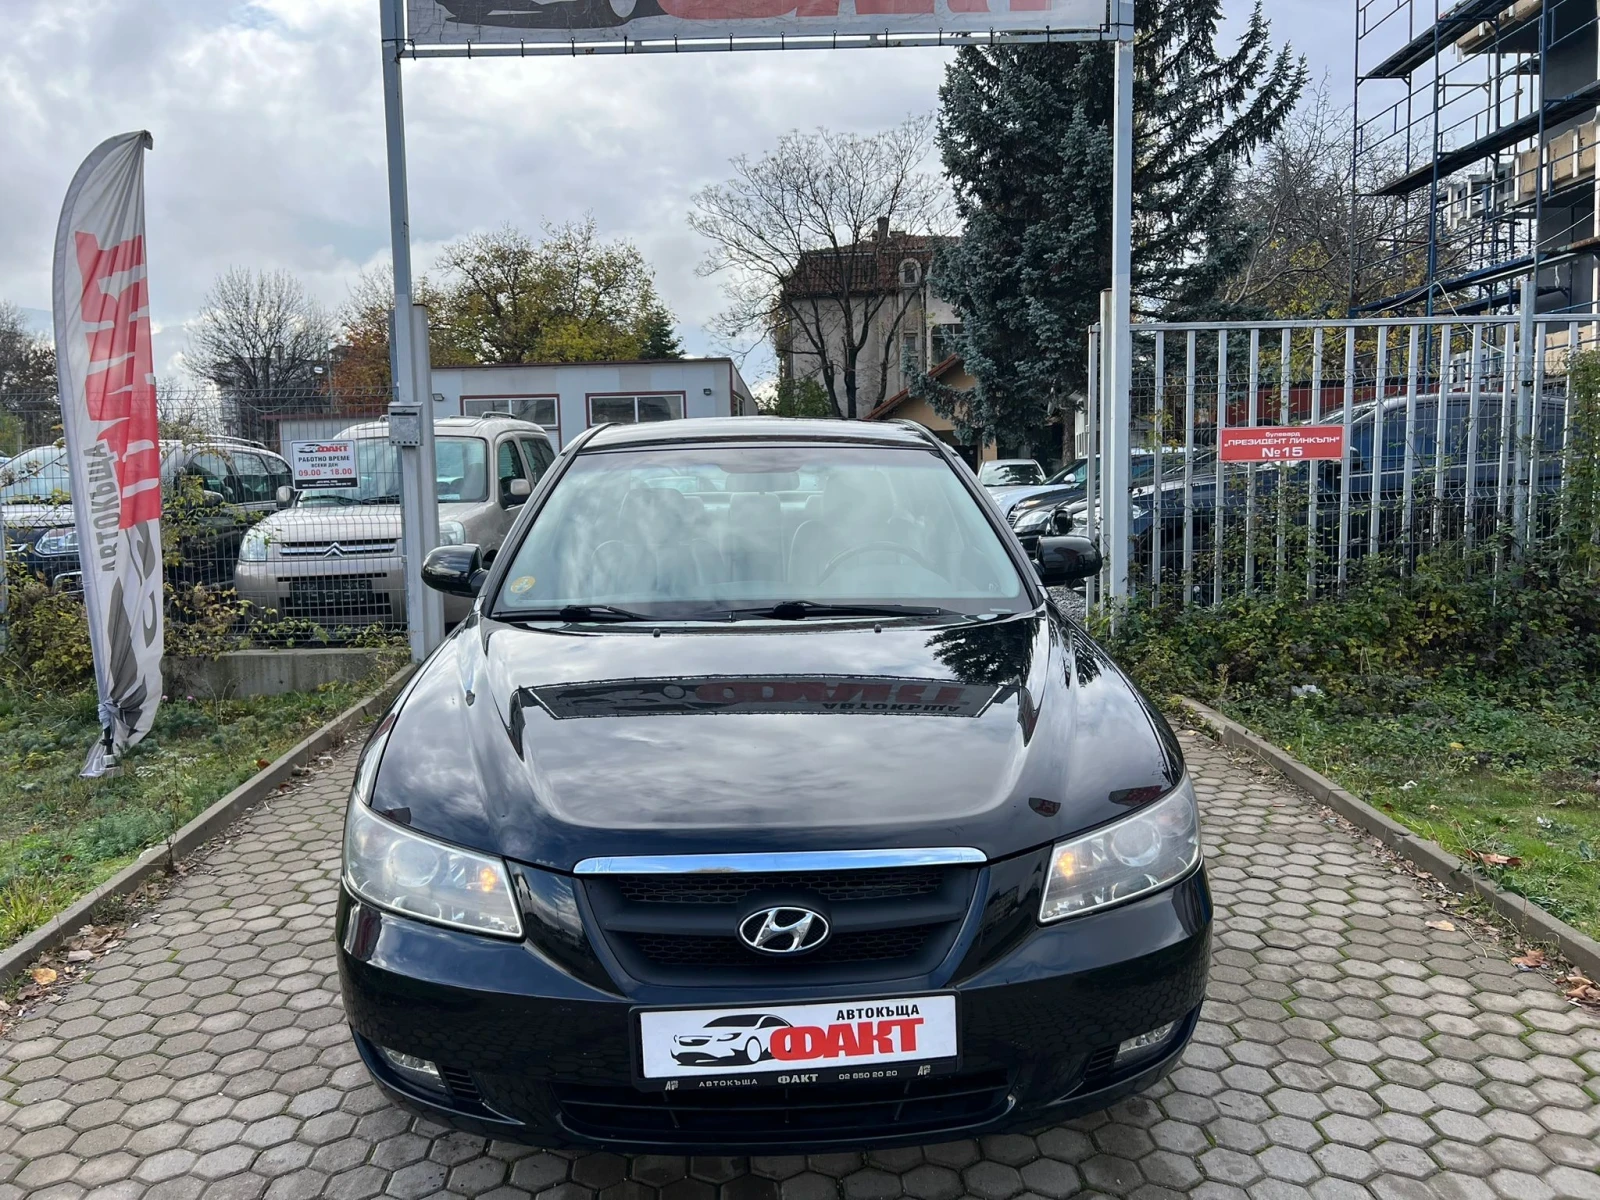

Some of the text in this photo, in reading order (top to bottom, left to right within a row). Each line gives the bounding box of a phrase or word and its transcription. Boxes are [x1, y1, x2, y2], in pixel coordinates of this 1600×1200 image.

[298, 469, 321, 477] 09.00
[330, 468, 353, 476] 18.00
[836, 1004, 920, 1021] АВТОКЪЩА
[769, 1017, 925, 1061] ФАКТ
[777, 1073, 819, 1084] ФАКТ
